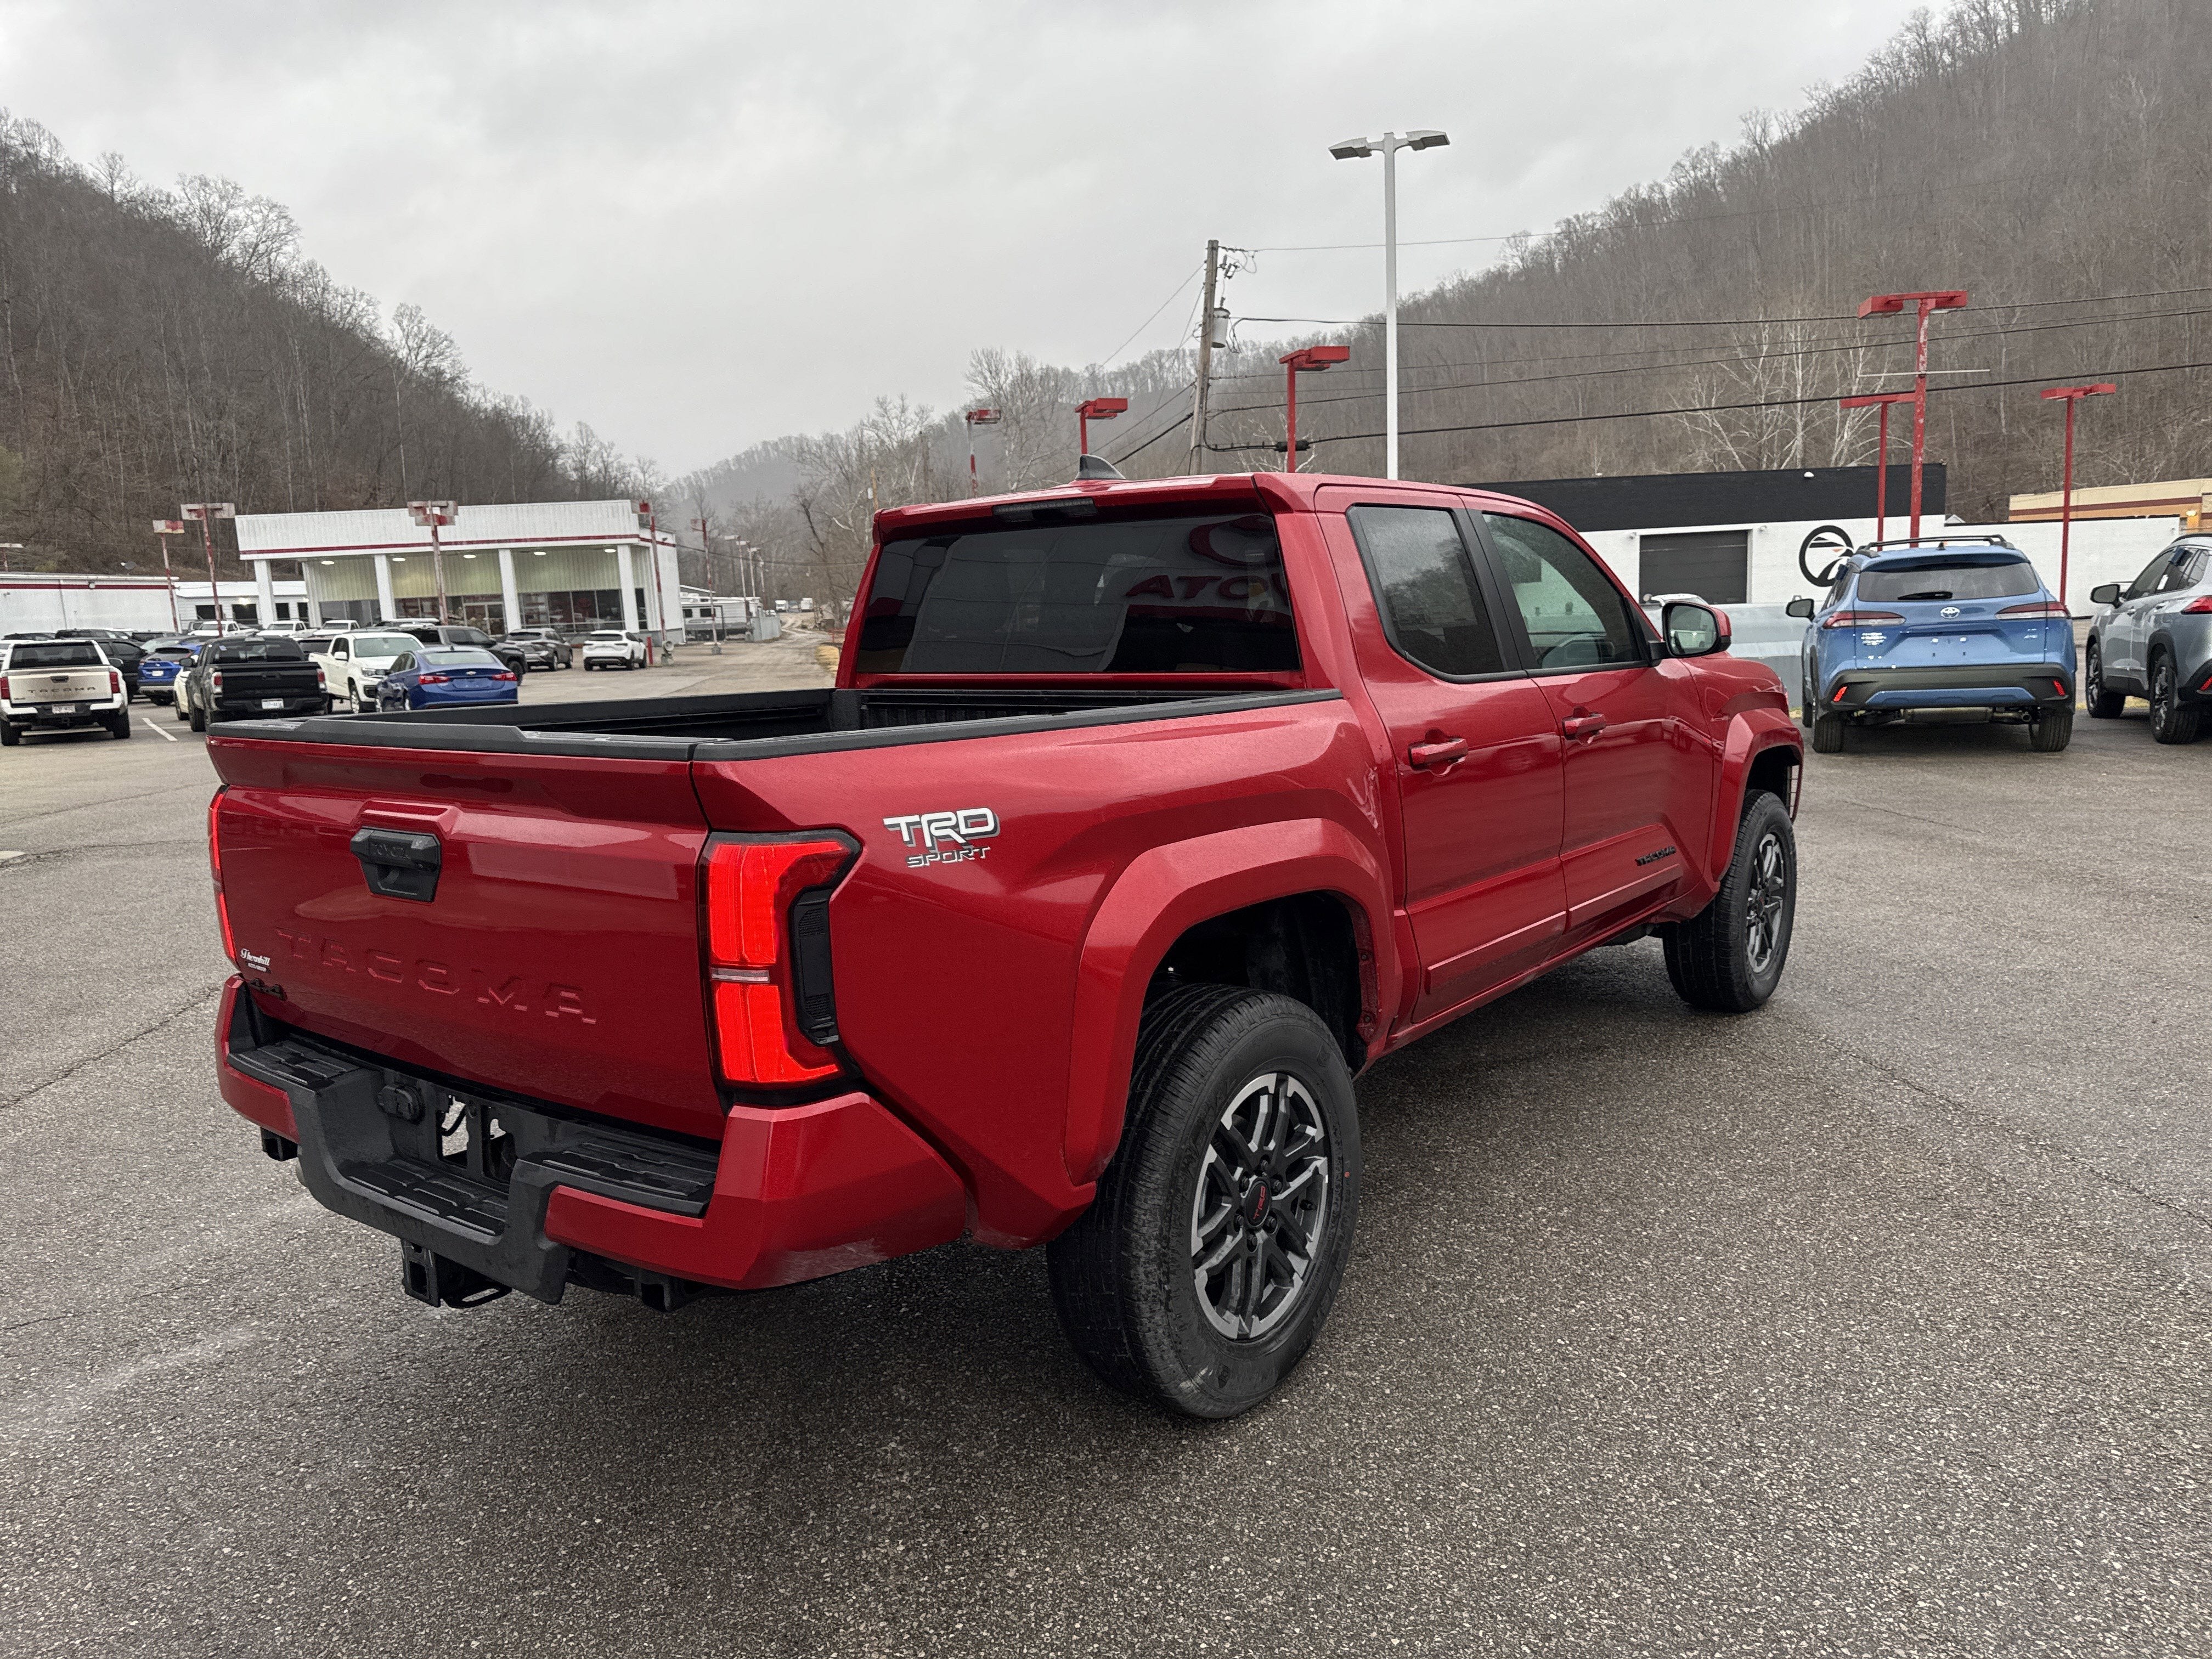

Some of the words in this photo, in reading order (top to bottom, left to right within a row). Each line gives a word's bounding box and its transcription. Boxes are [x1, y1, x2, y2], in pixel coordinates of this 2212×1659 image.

[883, 808, 1000, 853] TRD
[370, 843, 412, 860] TOYOTA
[906, 846, 990, 868] SPORT
[1635, 846, 1676, 866] TACOMA
[275, 927, 596, 1024] TACOMA
[1252, 1186, 1266, 1220] TRD
